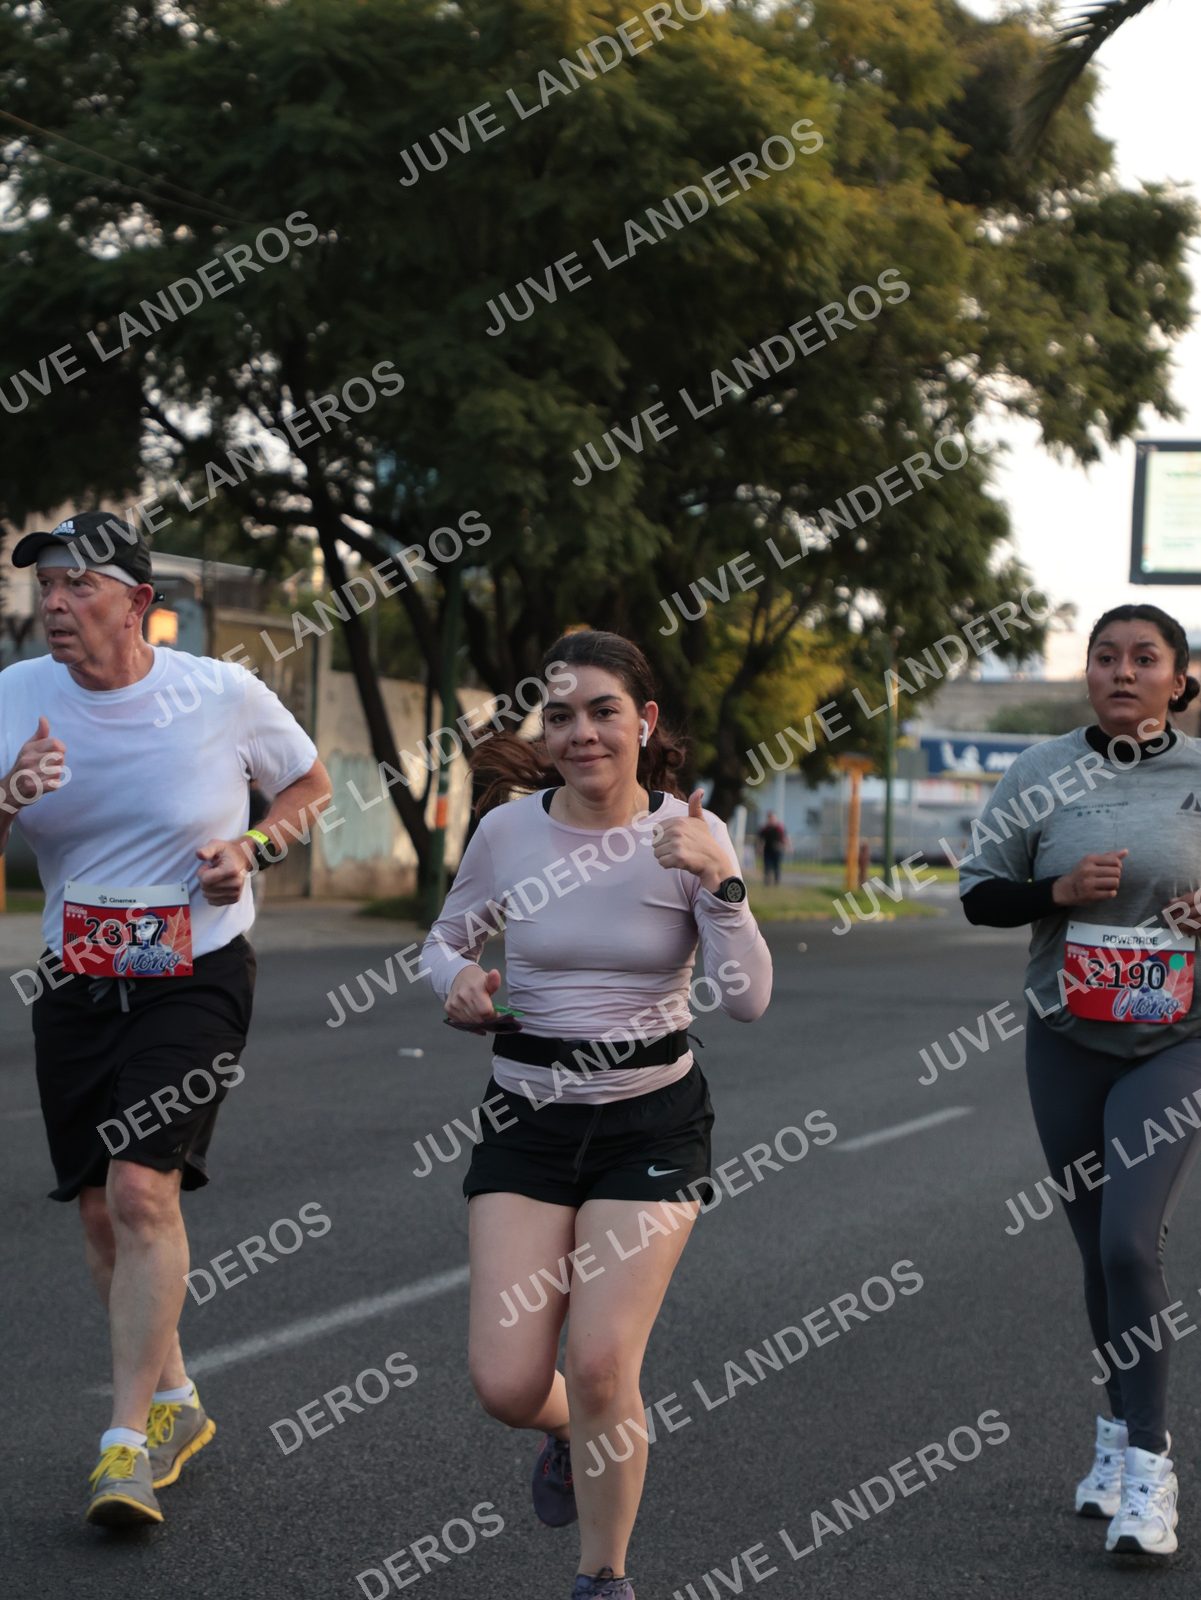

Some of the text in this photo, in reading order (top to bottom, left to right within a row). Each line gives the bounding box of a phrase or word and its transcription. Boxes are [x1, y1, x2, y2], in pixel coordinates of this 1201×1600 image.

[85, 917, 165, 946] 2317
[1102, 934, 1159, 946] POWERADE
[1085, 958, 1167, 989] 2190
